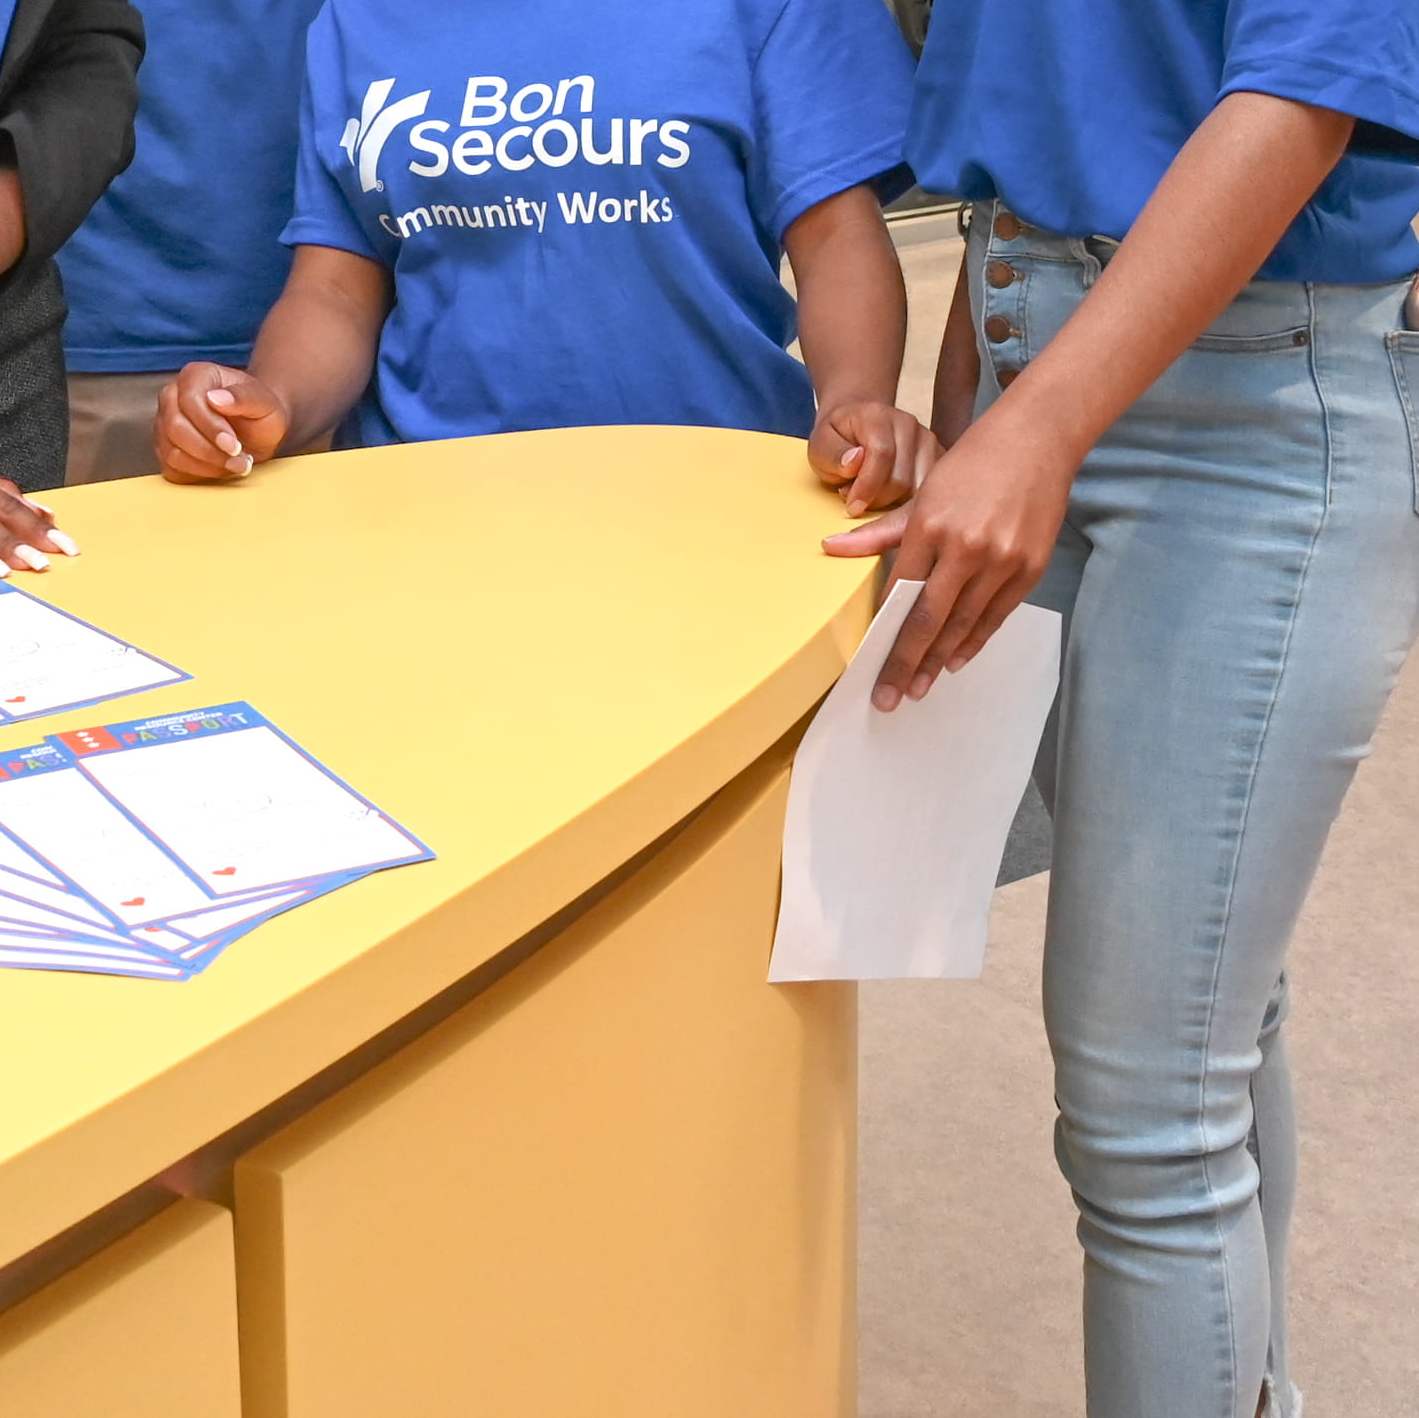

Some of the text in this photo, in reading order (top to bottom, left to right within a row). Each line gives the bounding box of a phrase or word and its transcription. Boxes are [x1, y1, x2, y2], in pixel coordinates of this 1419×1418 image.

[459, 74, 595, 127] Bon
[408, 117, 691, 178] Secours
[556, 189, 674, 225] Works
[121, 713, 249, 744] PASSPORT
